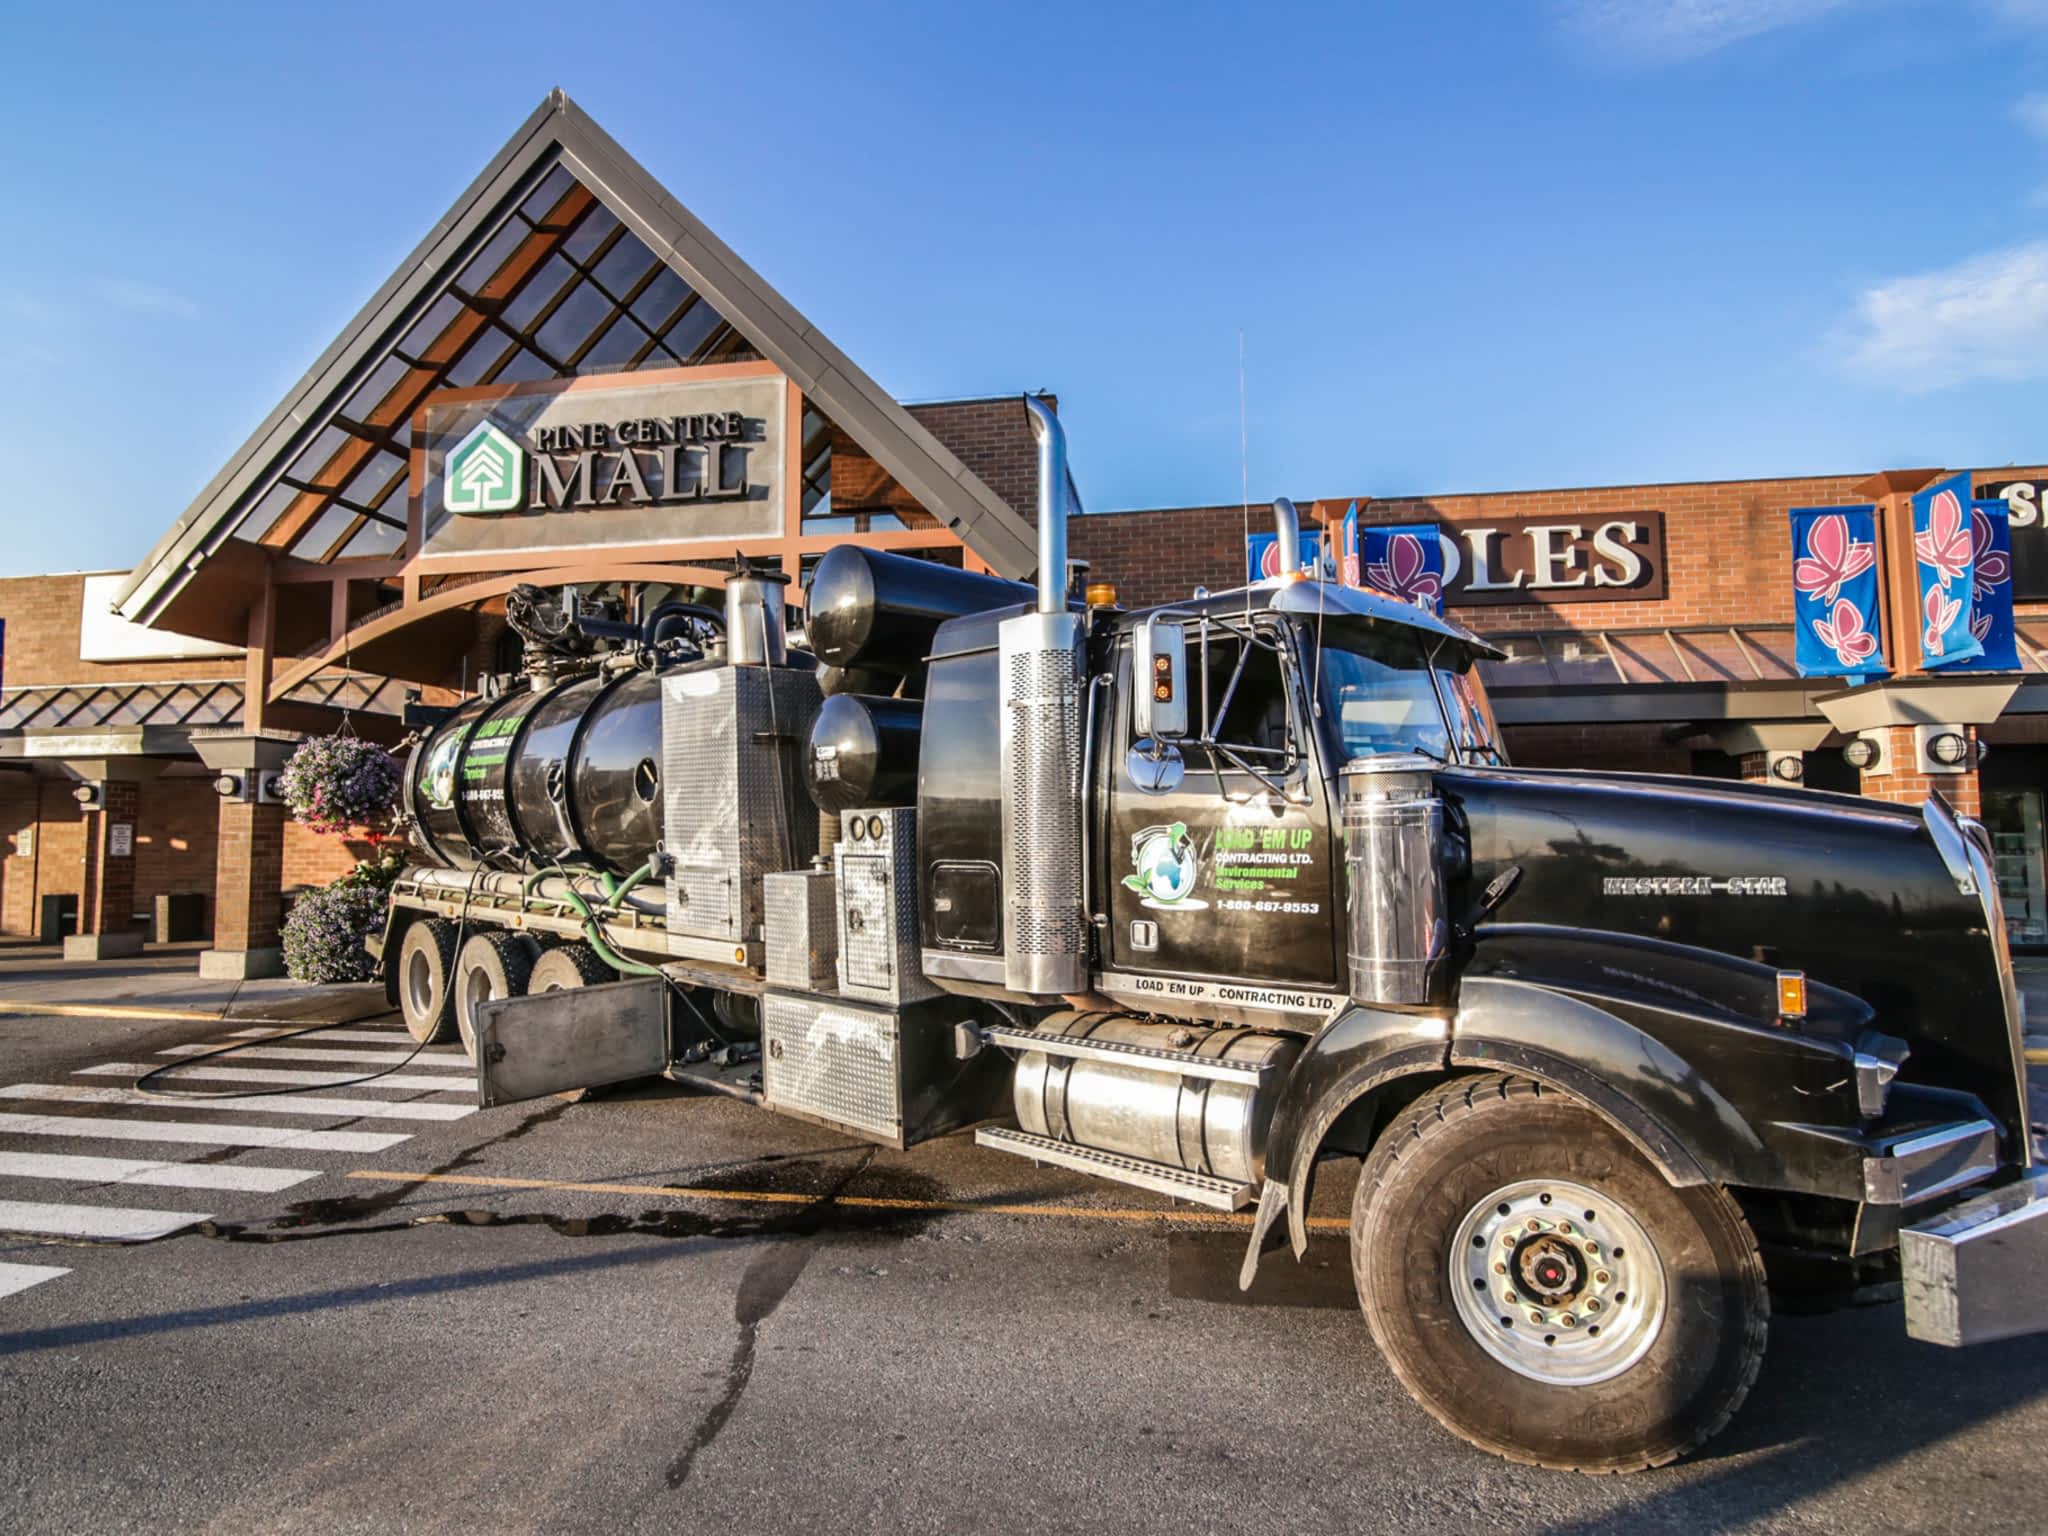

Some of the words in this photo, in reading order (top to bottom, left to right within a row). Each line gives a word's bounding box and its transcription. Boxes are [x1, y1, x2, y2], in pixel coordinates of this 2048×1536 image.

[536, 422, 610, 451] PINE
[615, 411, 743, 446] CENTRE
[530, 441, 746, 510] MALL
[1215, 828, 1255, 849] LOAD
[1290, 829, 1313, 849] UP
[1216, 852, 1288, 863] CONTRACTING
[1289, 854, 1314, 864] LTD.
[1215, 866, 1298, 878] Environmental
[1215, 878, 1265, 889] Services
[1603, 877, 1713, 896] WESTERN
[1727, 877, 1788, 896] STAR
[1136, 979, 1164, 992] LOAD
[1189, 984, 1205, 996] UP
[1219, 987, 1305, 1008] CONTRACTING
[1308, 996, 1337, 1011] LTD.
